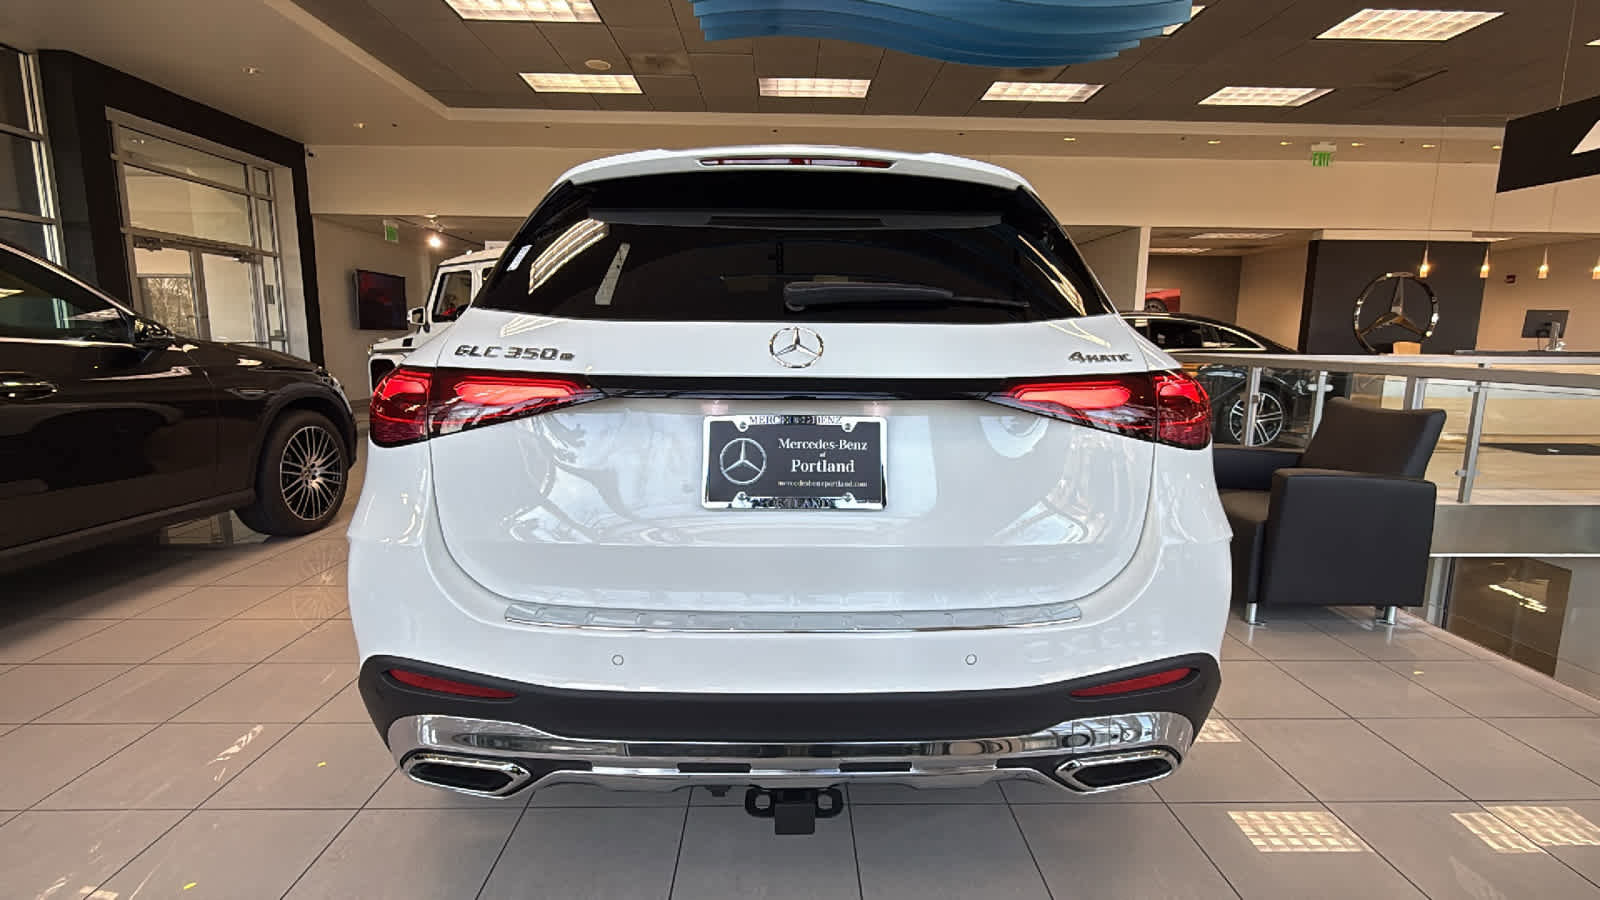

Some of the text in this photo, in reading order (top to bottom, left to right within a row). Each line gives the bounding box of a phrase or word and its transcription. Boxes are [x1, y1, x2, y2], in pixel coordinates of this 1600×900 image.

[454, 345, 502, 357] GLC
[1068, 351, 1132, 363] 4MATIC
[778, 438, 867, 450] Mercedes-Benz
[791, 459, 855, 473] Portland
